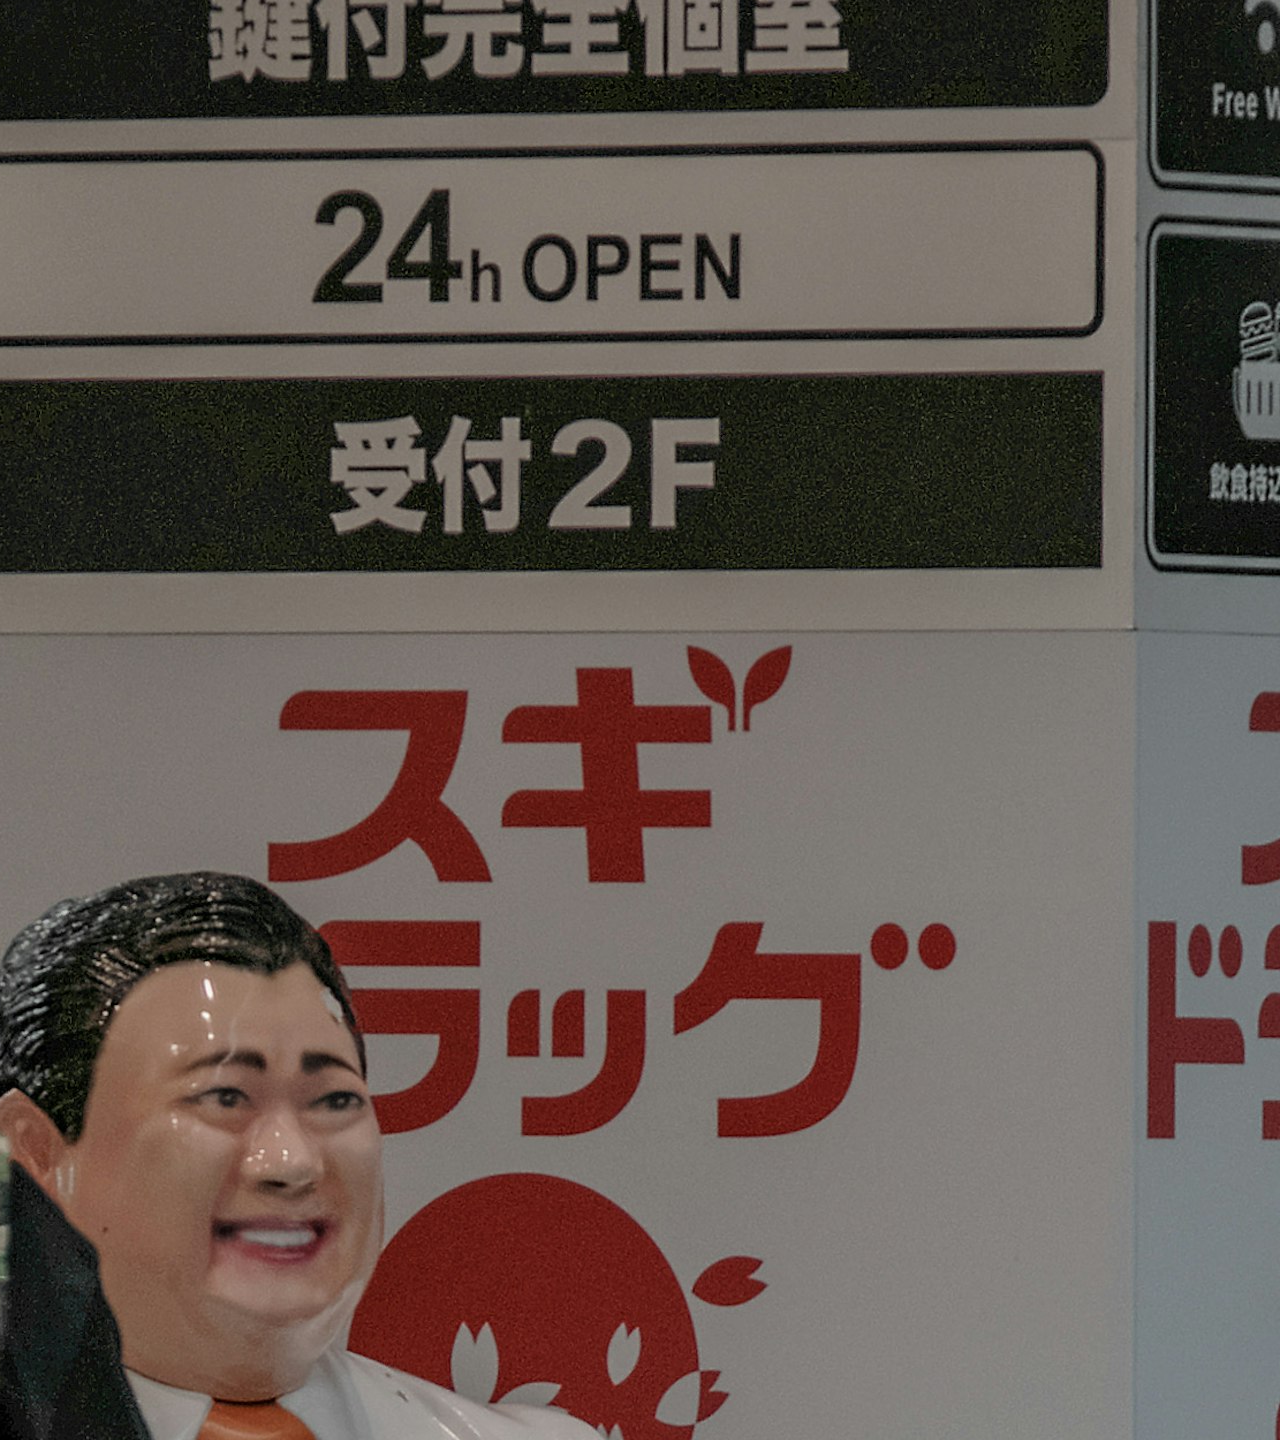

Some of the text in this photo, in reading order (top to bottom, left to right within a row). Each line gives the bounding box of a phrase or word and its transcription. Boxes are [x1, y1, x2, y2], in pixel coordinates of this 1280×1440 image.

[1211, 84, 1259, 123] Free
[312, 189, 743, 306] 24h OPEN
[266, 645, 793, 886] スギ
